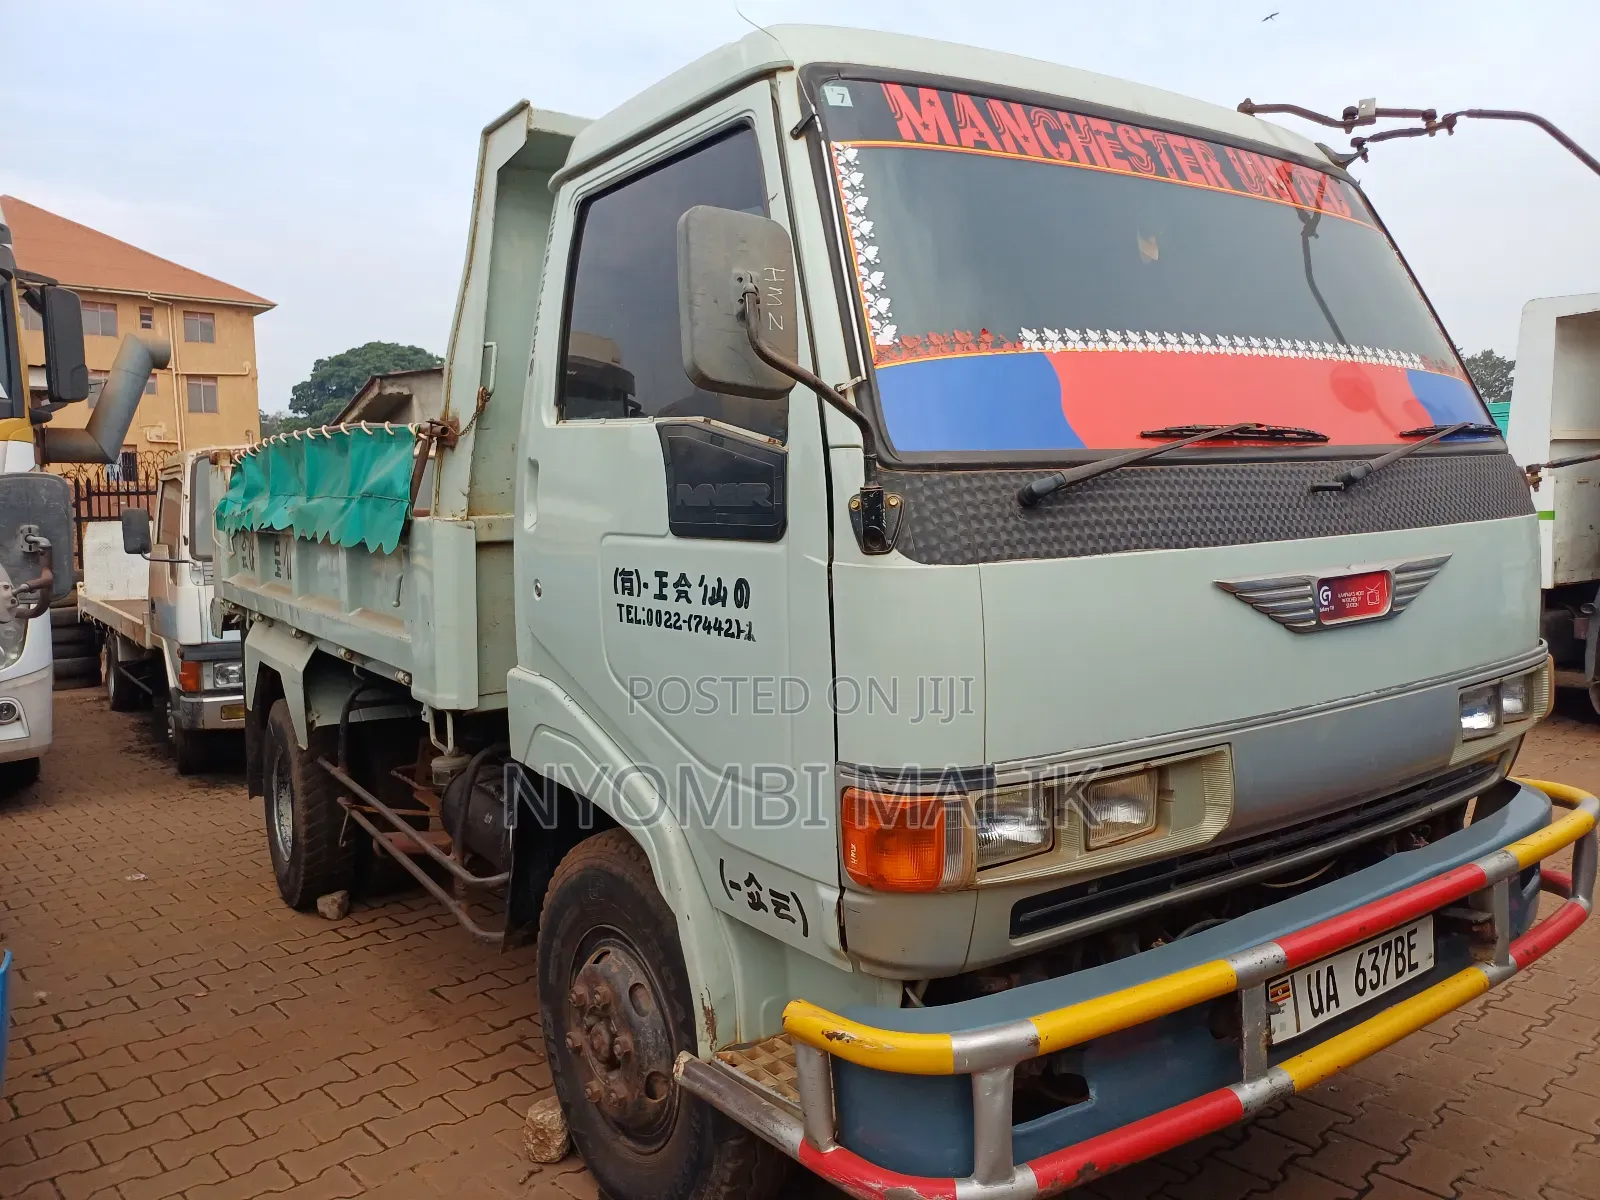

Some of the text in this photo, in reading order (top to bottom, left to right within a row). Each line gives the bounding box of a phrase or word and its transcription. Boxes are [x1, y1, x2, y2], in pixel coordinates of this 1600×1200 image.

[880, 82, 1233, 190] MANCHESTER
[1306, 927, 1419, 1019] UA 637BE
